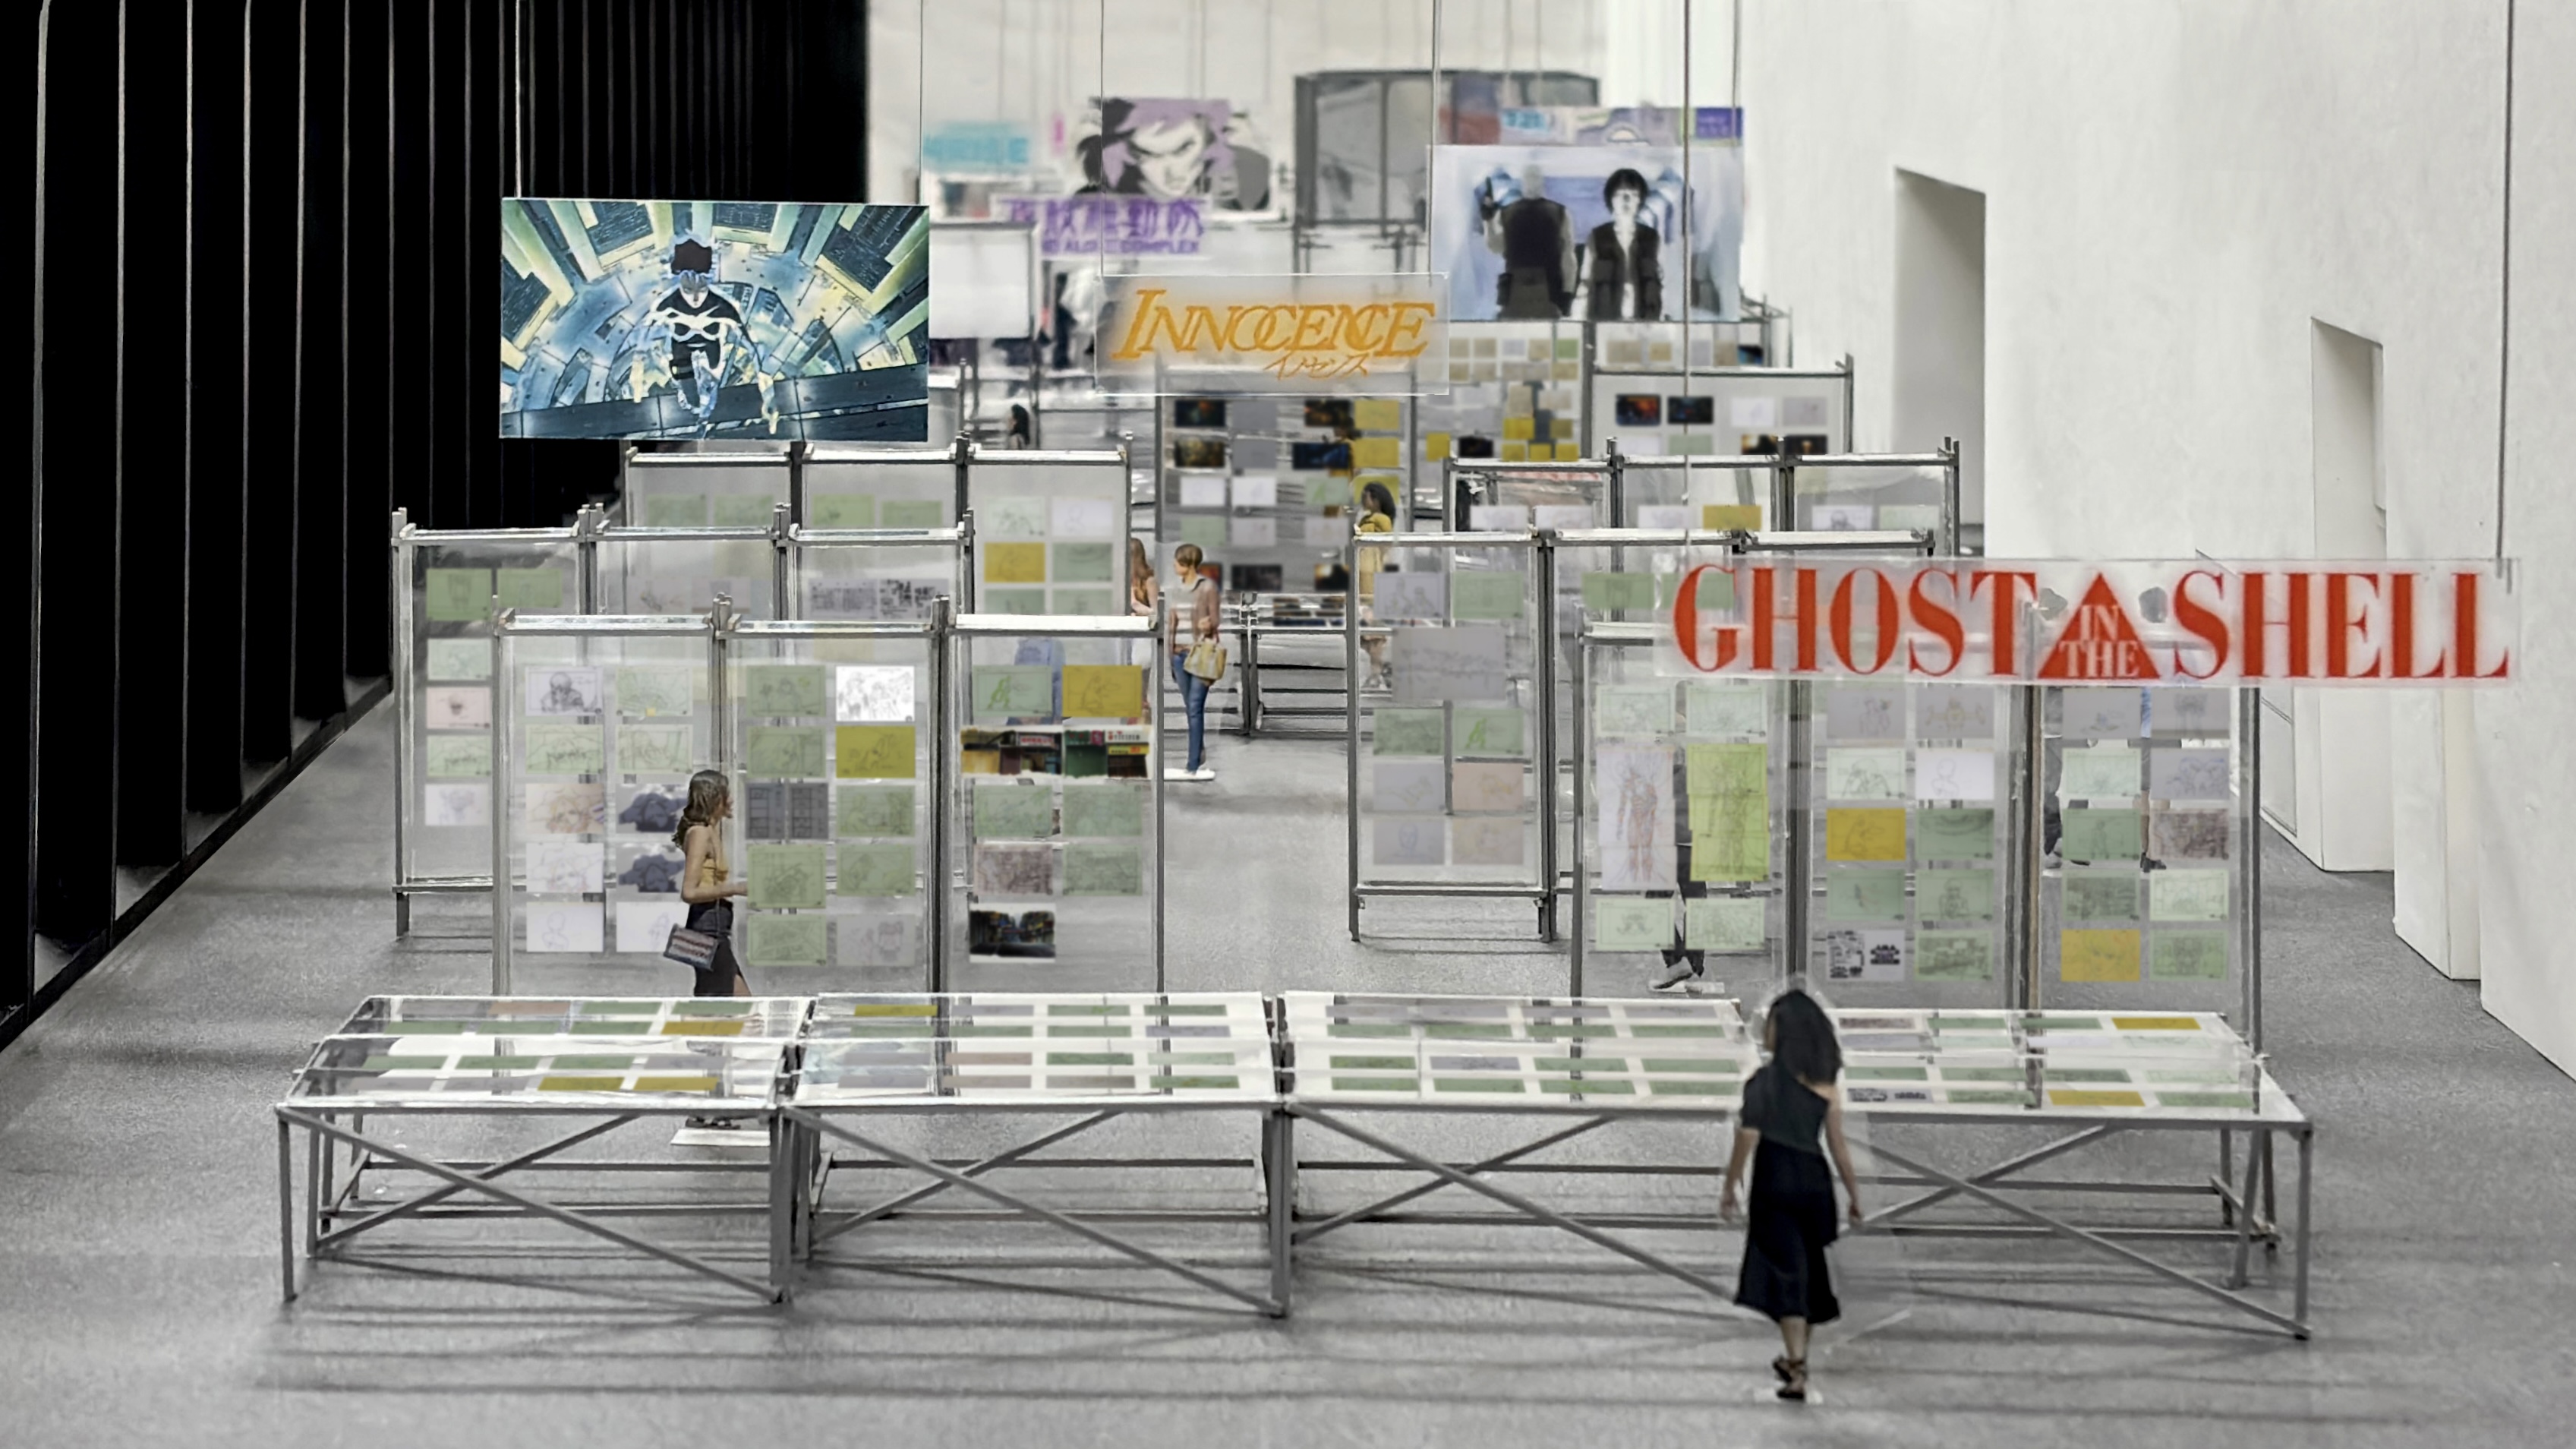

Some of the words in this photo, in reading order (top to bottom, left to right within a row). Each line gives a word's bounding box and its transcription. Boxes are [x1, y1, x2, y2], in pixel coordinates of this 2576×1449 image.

[1111, 289, 1436, 359] INNOCENCE
[1673, 565, 2037, 675] GHOST
[2079, 605, 2120, 642] IN
[2174, 572, 2509, 678] SHELL
[2058, 640, 2140, 677] THE
